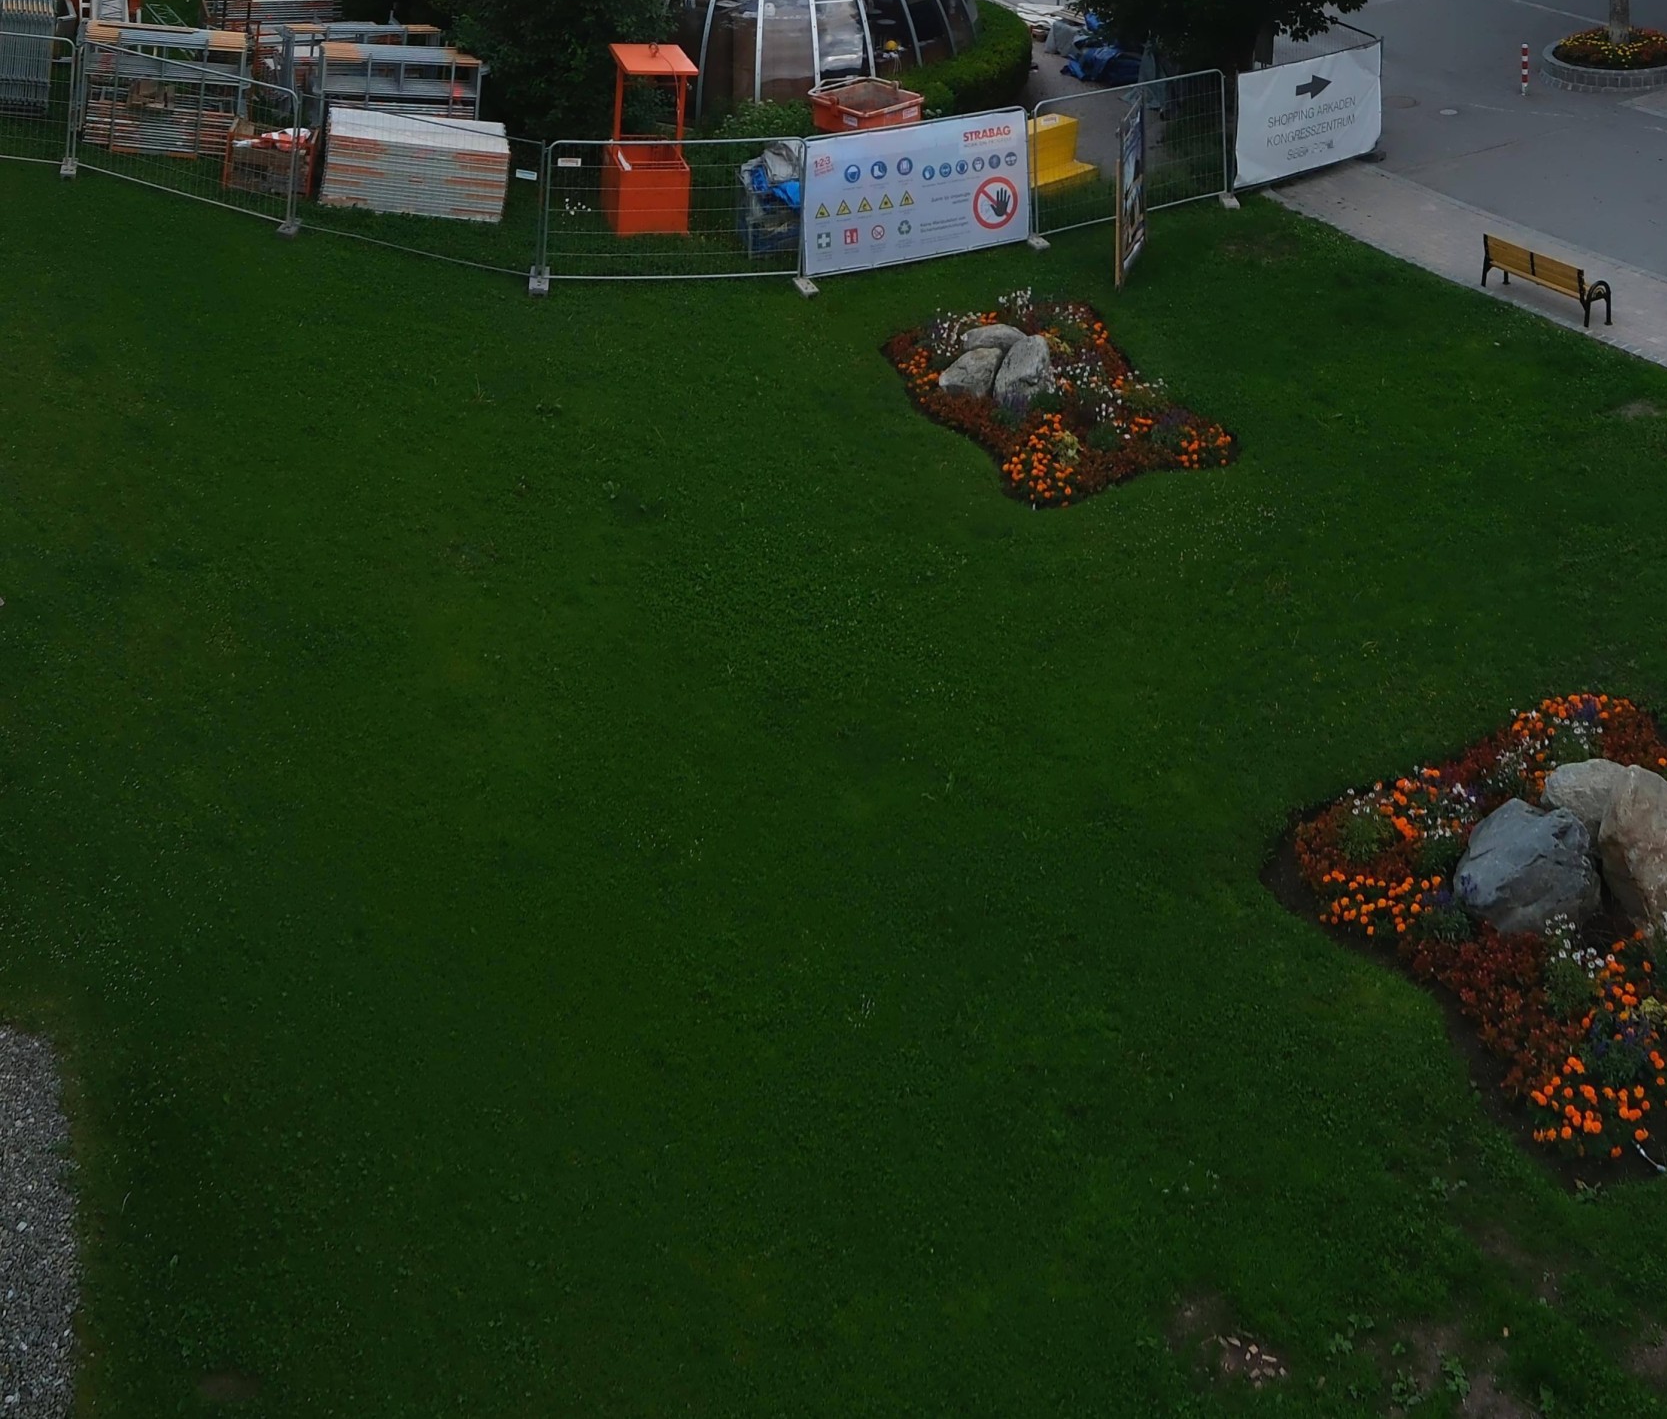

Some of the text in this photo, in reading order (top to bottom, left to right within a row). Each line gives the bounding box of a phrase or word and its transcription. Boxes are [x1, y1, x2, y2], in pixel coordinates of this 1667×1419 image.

[1267, 96, 1356, 128] SHOPPING ARKADEN
[963, 125, 1011, 142] STRABAG
[1266, 113, 1356, 147] KONGRESSZENTRUM
